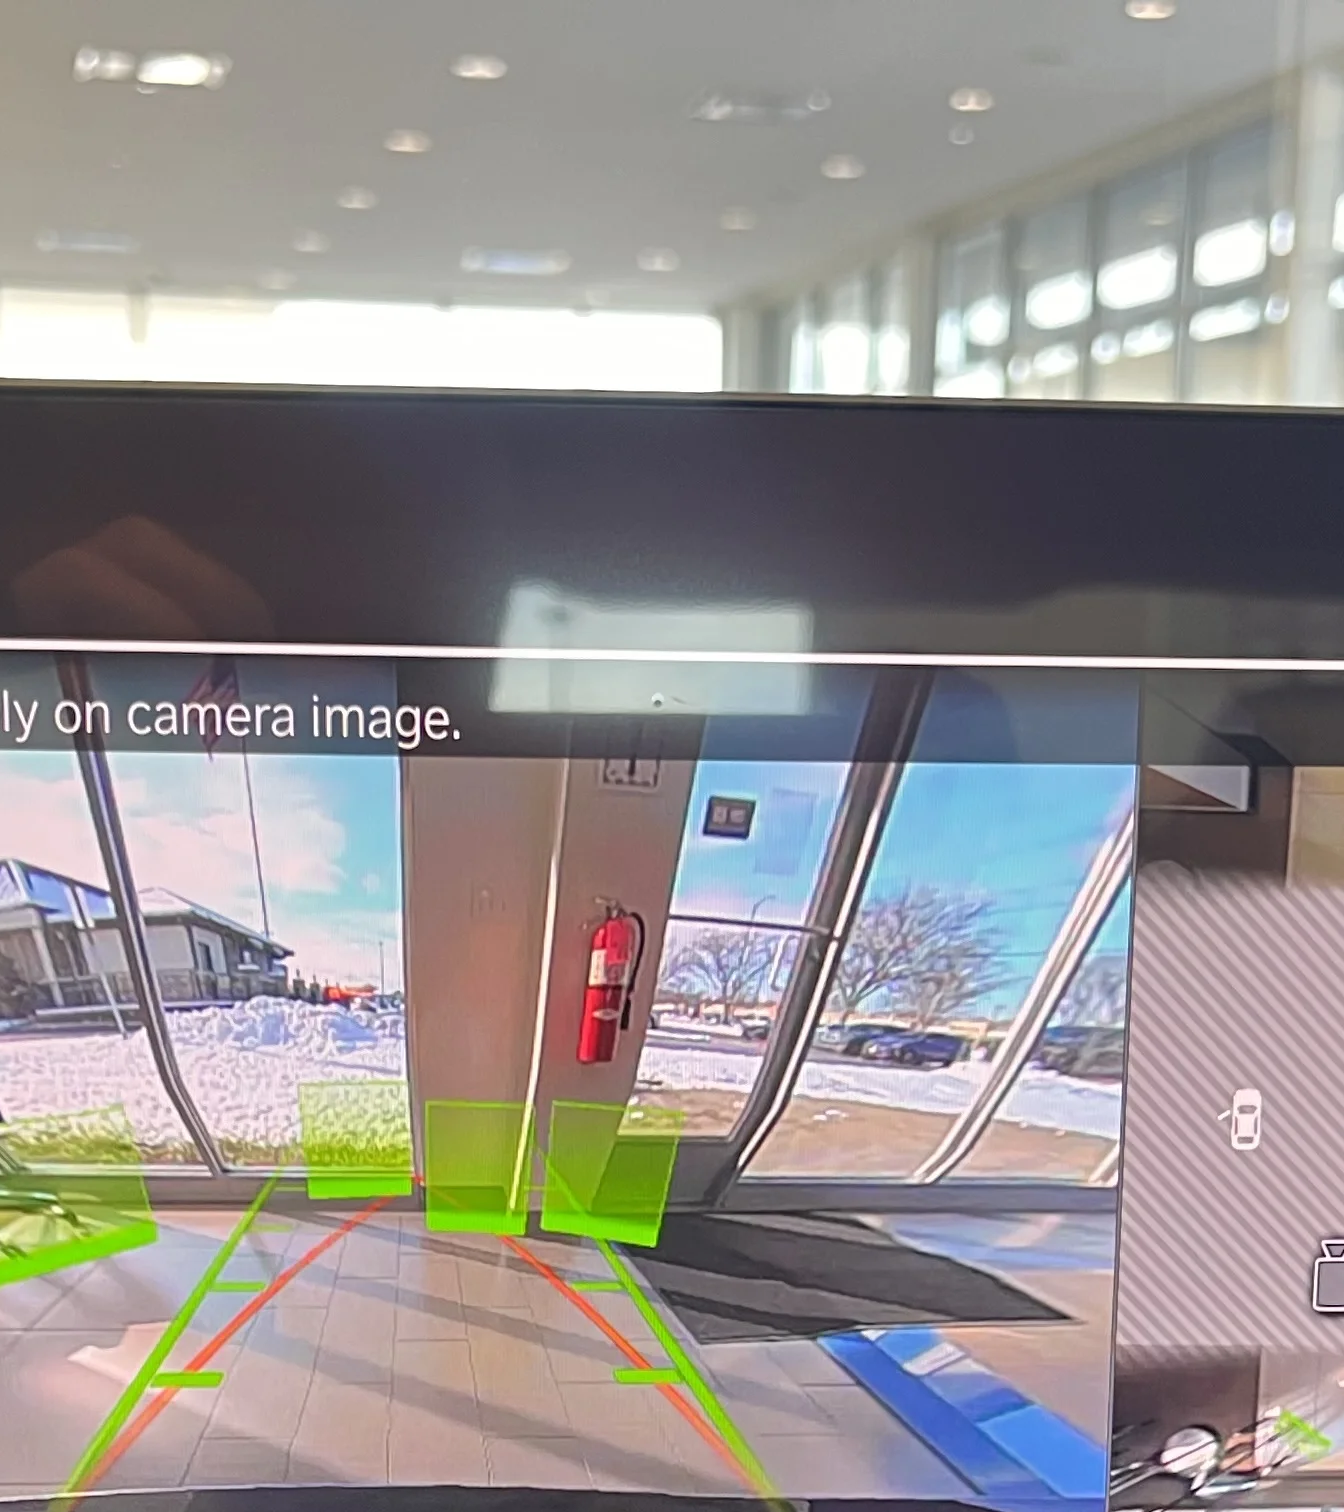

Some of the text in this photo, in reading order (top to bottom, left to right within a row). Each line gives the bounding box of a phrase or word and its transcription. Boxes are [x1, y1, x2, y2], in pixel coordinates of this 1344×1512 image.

[53, 700, 112, 735] on
[126, 700, 297, 739] camera
[311, 694, 462, 750] image.
